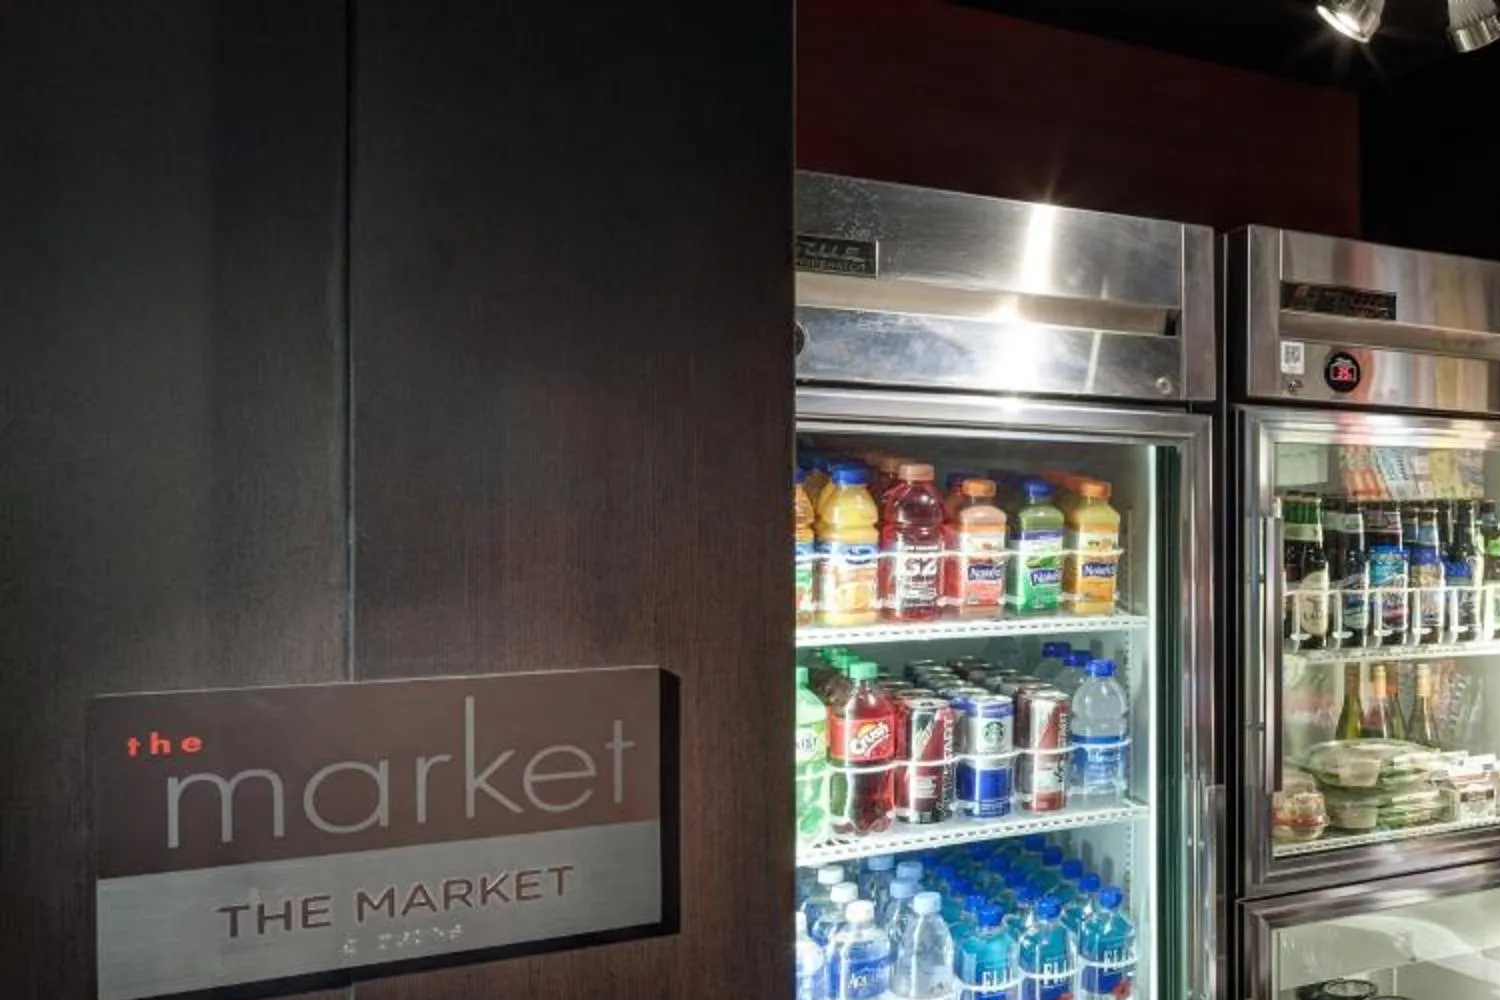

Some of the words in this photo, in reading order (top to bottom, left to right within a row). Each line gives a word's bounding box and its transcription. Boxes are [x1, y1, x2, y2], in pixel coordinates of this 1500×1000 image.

[127, 732, 203, 757] the
[166, 697, 635, 849] market
[217, 896, 332, 939] THE
[356, 866, 575, 924] MARKET
